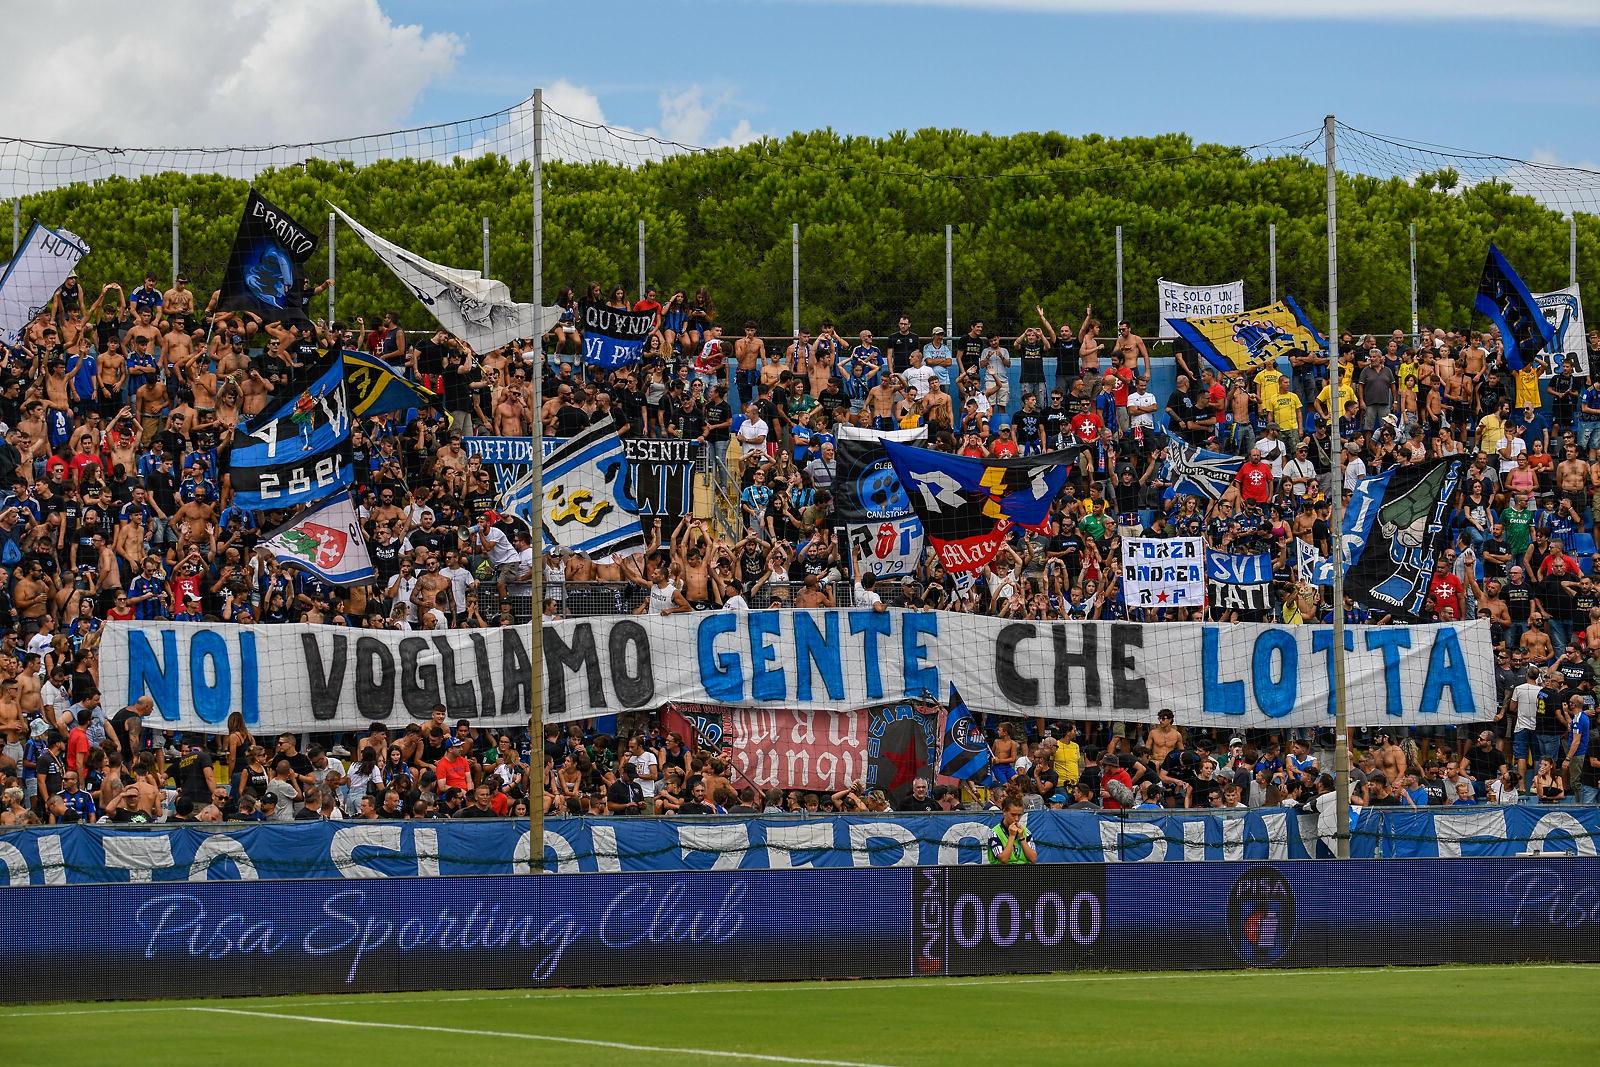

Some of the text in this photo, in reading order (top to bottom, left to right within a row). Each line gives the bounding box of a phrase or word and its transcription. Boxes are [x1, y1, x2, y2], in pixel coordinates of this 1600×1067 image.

[252, 200, 313, 254] BRANCO
[1183, 291, 1211, 302] SOLO
[1218, 291, 1232, 301] UN
[1164, 302, 1240, 315] PREPARATORE
[621, 439, 689, 462] ESENTI
[1128, 541, 1196, 559] FORZA
[1125, 565, 1200, 582] ANDREA
[1210, 552, 1263, 584] SVI
[1139, 588, 1186, 604] R P
[1208, 579, 1273, 610] TATI
[127, 610, 1477, 724] NOI VOGLIAMO GENTE CHE LOTTA
[1235, 876, 1288, 898] PISA
[953, 890, 1102, 949] 00:00
[135, 880, 749, 984] Pisa Sporting Club
